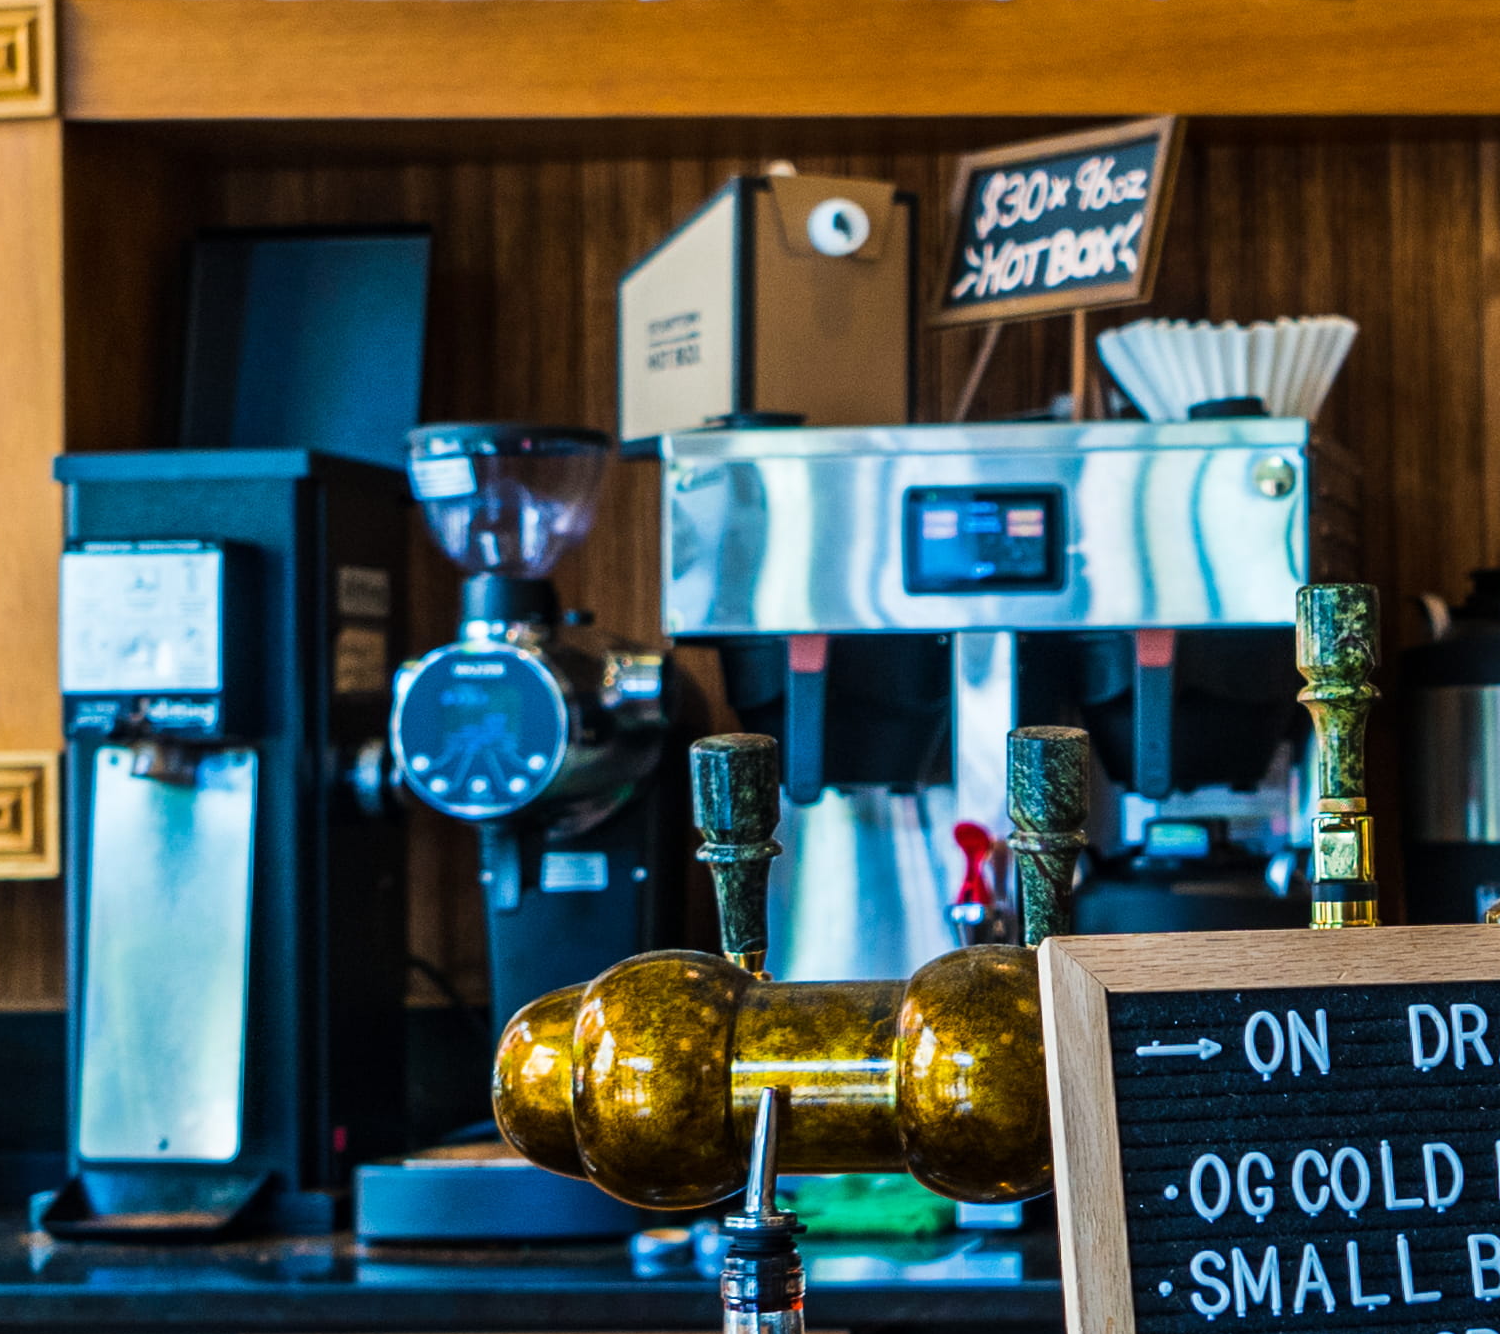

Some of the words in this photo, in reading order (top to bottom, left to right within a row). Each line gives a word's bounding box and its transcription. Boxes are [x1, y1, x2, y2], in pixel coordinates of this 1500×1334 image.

[976, 170, 1049, 239] $30
[974, 237, 1050, 297] HOT
[1044, 225, 1126, 287] BOX
[1245, 1009, 1329, 1081] ON
[1190, 1152, 1273, 1223] OG
[1292, 1140, 1463, 1217] COLD
[1190, 1234, 1441, 1320] SMALL
